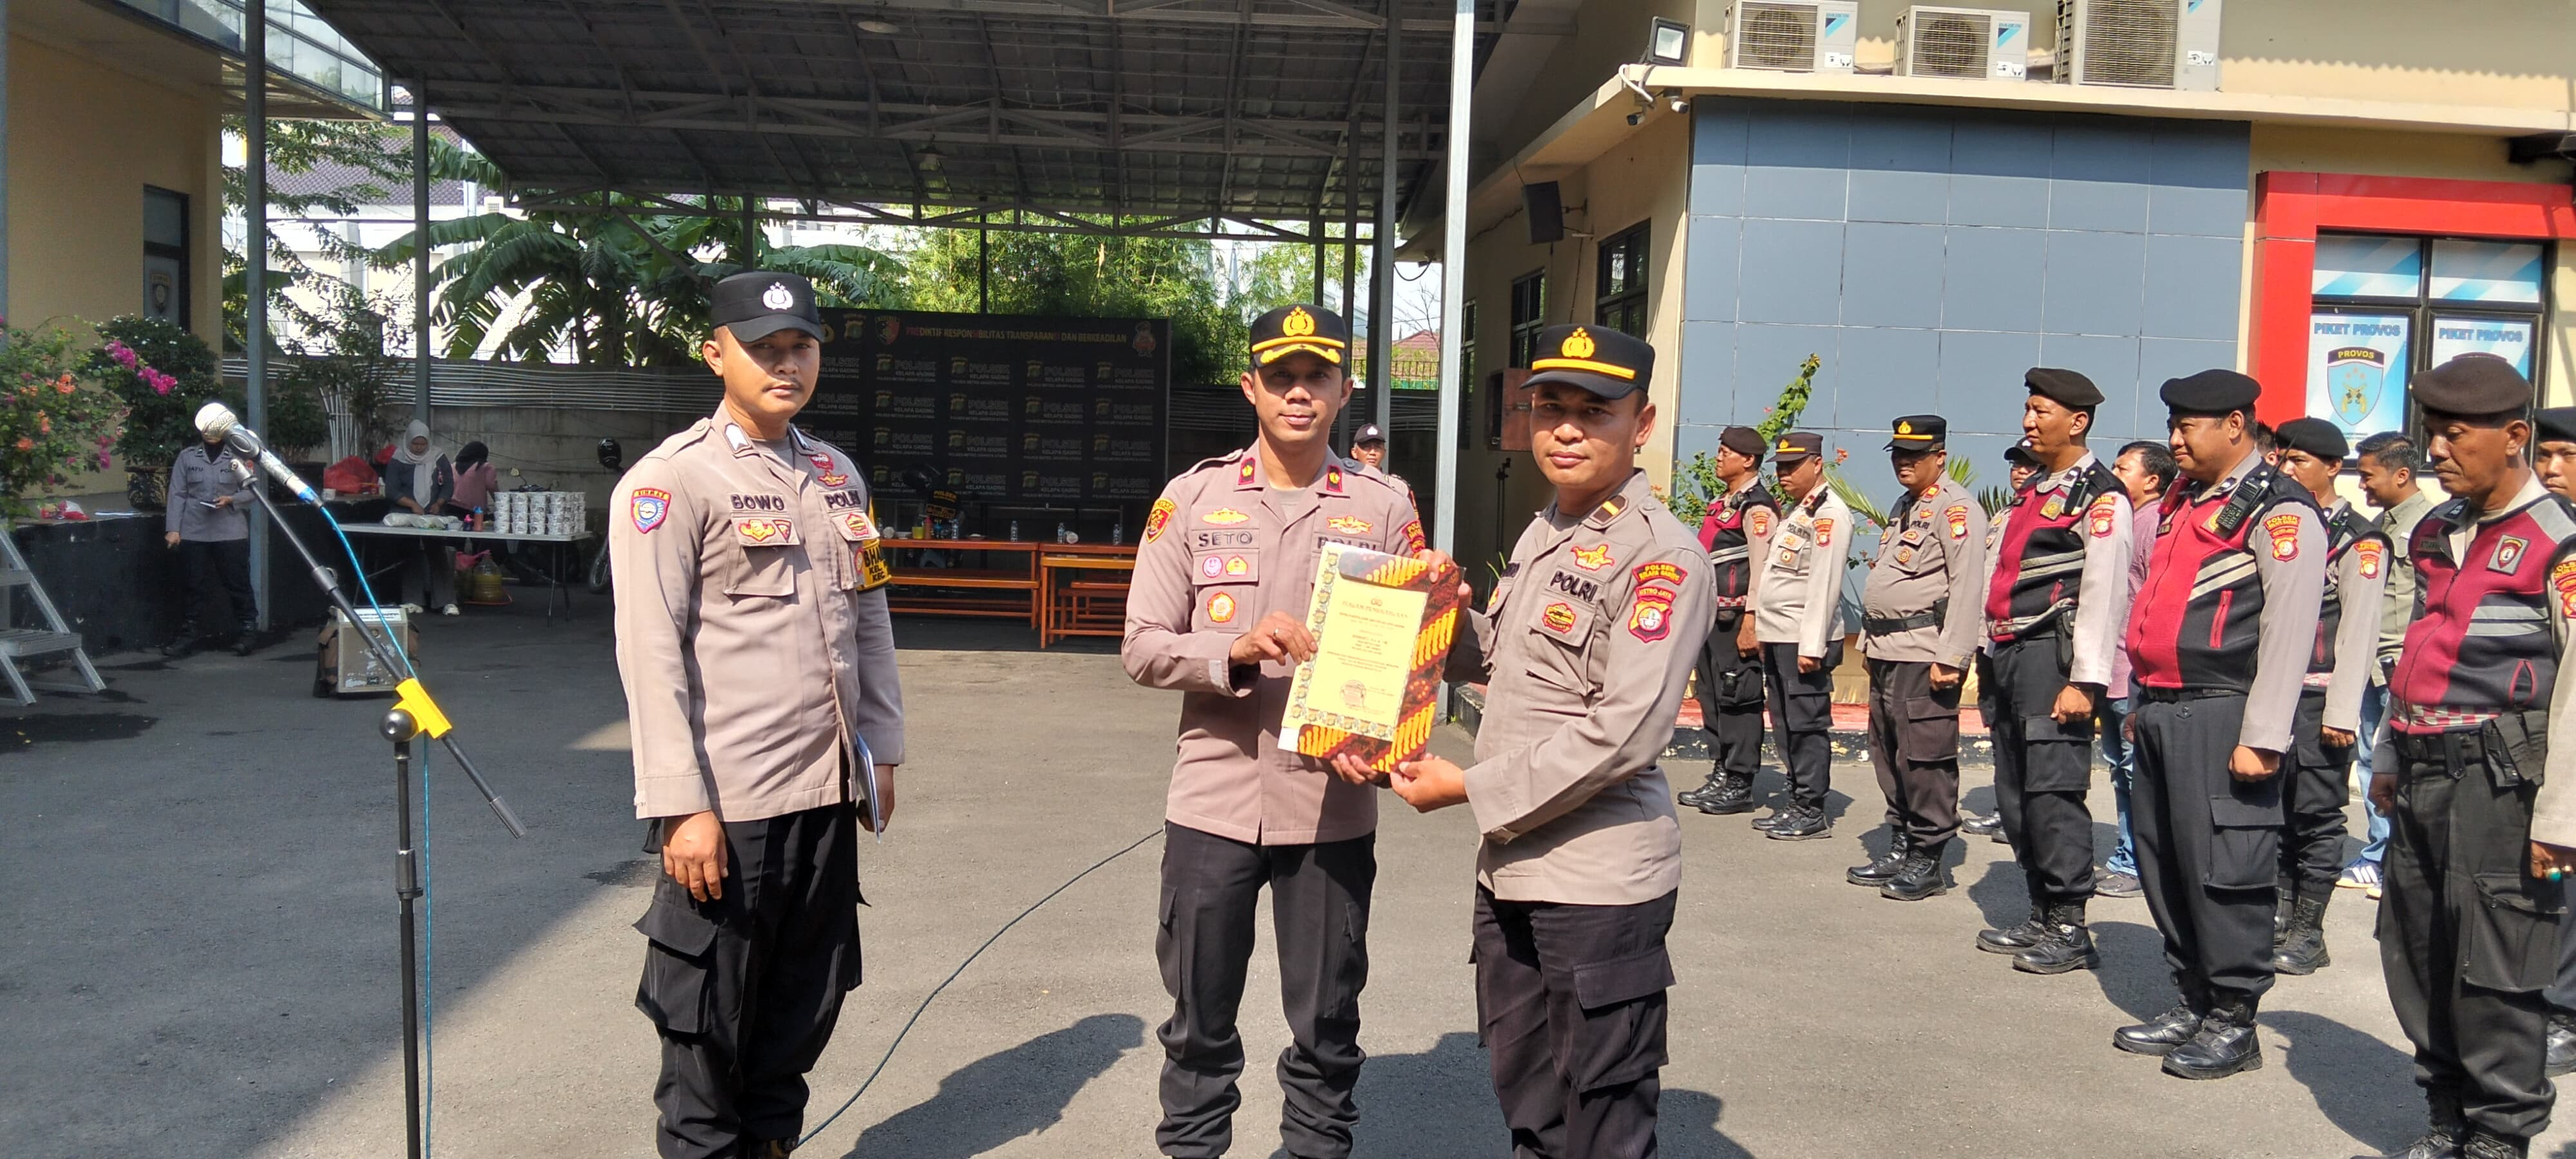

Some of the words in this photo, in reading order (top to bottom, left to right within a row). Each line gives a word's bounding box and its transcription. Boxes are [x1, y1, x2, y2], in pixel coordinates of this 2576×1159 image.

[2315, 323, 2350, 335] PIKET
[2353, 324, 2401, 336] PROVOS
[1061, 332, 1077, 342] DAN
[1078, 333, 1127, 343] BERKEADILAN
[2439, 328, 2474, 339] PIKET
[2477, 330, 2523, 343] PROVOS
[2338, 350, 2374, 359] PROVOS
[820, 357, 860, 368] POLSEK
[895, 361, 936, 371] POLSEK
[969, 363, 1010, 373] POLSEK
[1044, 366, 1084, 377] POLSEK
[817, 393, 858, 403] POLSEK
[894, 397, 935, 407] POLSEK
[968, 400, 1009, 410] POLSEK
[1043, 402, 1084, 413] POLSEK
[815, 430, 857, 440] POLSEK
[892, 433, 933, 444] POLSEK
[967, 437, 1007, 446] POLSEK
[1043, 439, 1082, 449] POLSEK
[965, 475, 1006, 484] POLSEK
[1041, 476, 1081, 487] POLSEK
[730, 494, 784, 511] BOWO
[1910, 520, 1930, 529] POLRI
[2266, 515, 2298, 525] POLSEK
[1198, 531, 1253, 547] SETO
[1644, 565, 1676, 574] POLSEK
[1550, 570, 1598, 603] POLRI
